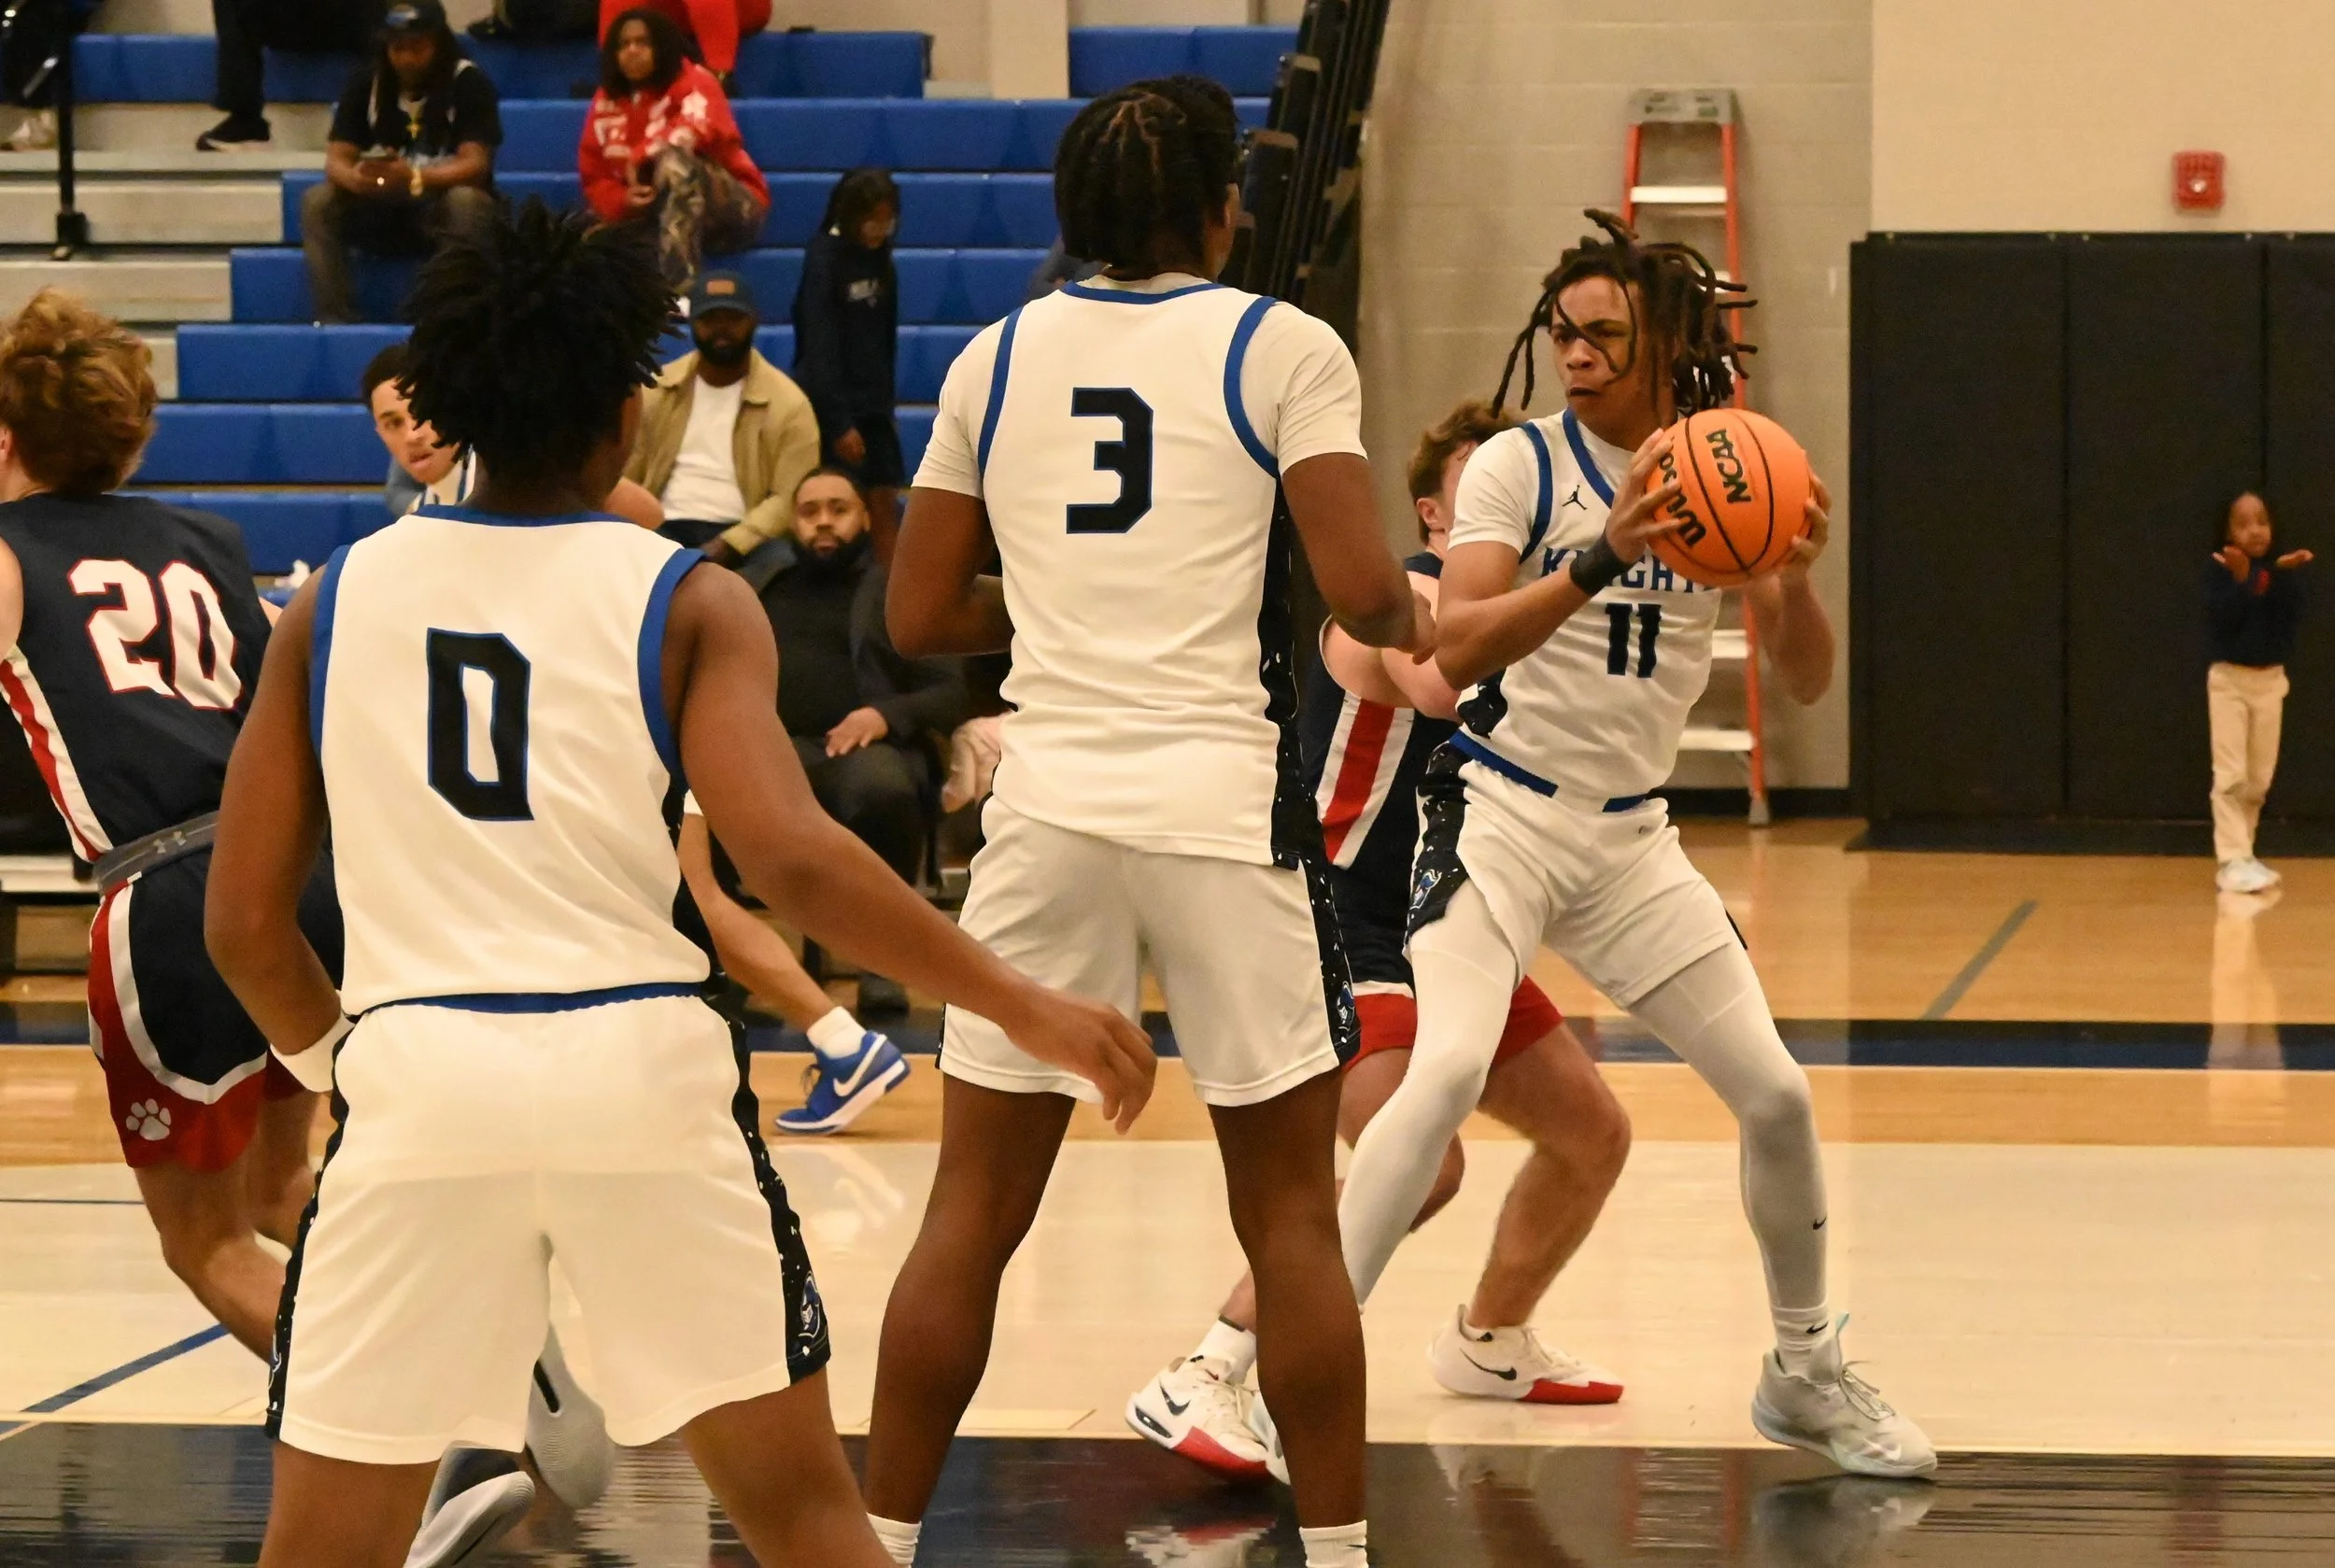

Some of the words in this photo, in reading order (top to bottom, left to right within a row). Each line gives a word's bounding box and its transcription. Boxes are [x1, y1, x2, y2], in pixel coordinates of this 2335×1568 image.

[1066, 387, 1154, 535] 3
[1659, 434, 1707, 546] Wiso
[1705, 429, 1752, 504] NCAA
[67, 558, 244, 711] 20
[1605, 602, 1663, 679] 11
[427, 627, 535, 822] 0
